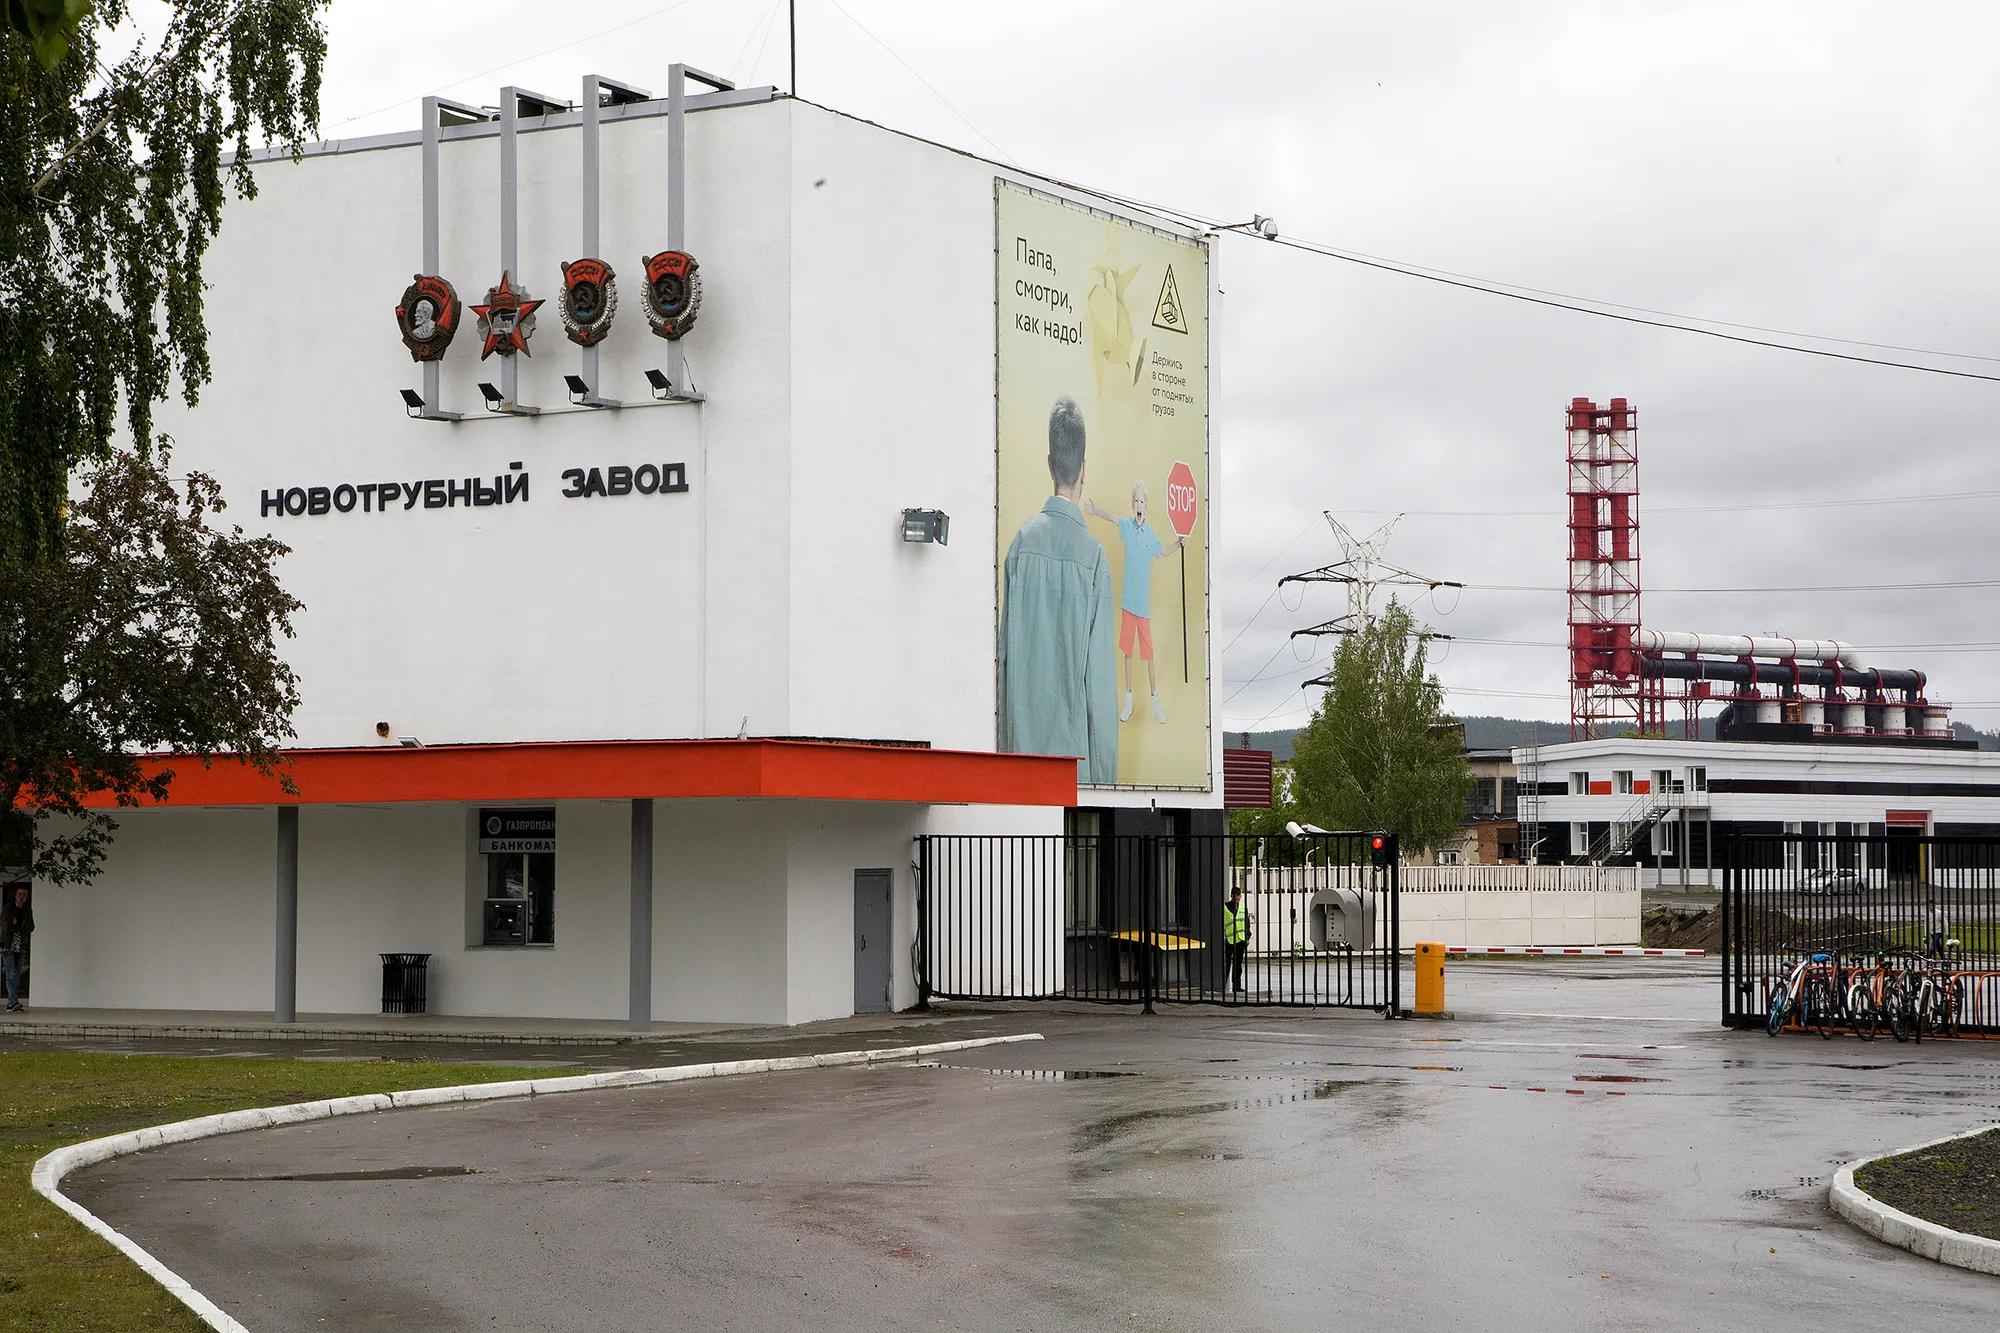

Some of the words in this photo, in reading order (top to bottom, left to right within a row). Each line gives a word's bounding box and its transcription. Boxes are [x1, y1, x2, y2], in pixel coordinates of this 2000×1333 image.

[1016, 236, 1057, 276] Папа,
[1015, 279, 1073, 314] смотри,
[1015, 312, 1040, 335] как
[1043, 320, 1082, 346] надо!
[1151, 351, 1183, 369] Держись
[1152, 371, 1157, 380] в
[1157, 372, 1187, 387] стороне
[1152, 387, 1161, 397] от
[1161, 389, 1194, 405] поднятых
[1152, 403, 1176, 417] грузов
[261, 461, 530, 518] НОВОТРУБНЫЙ
[561, 462, 690, 499] ЗАВОД
[1168, 483, 1196, 513] STOP
